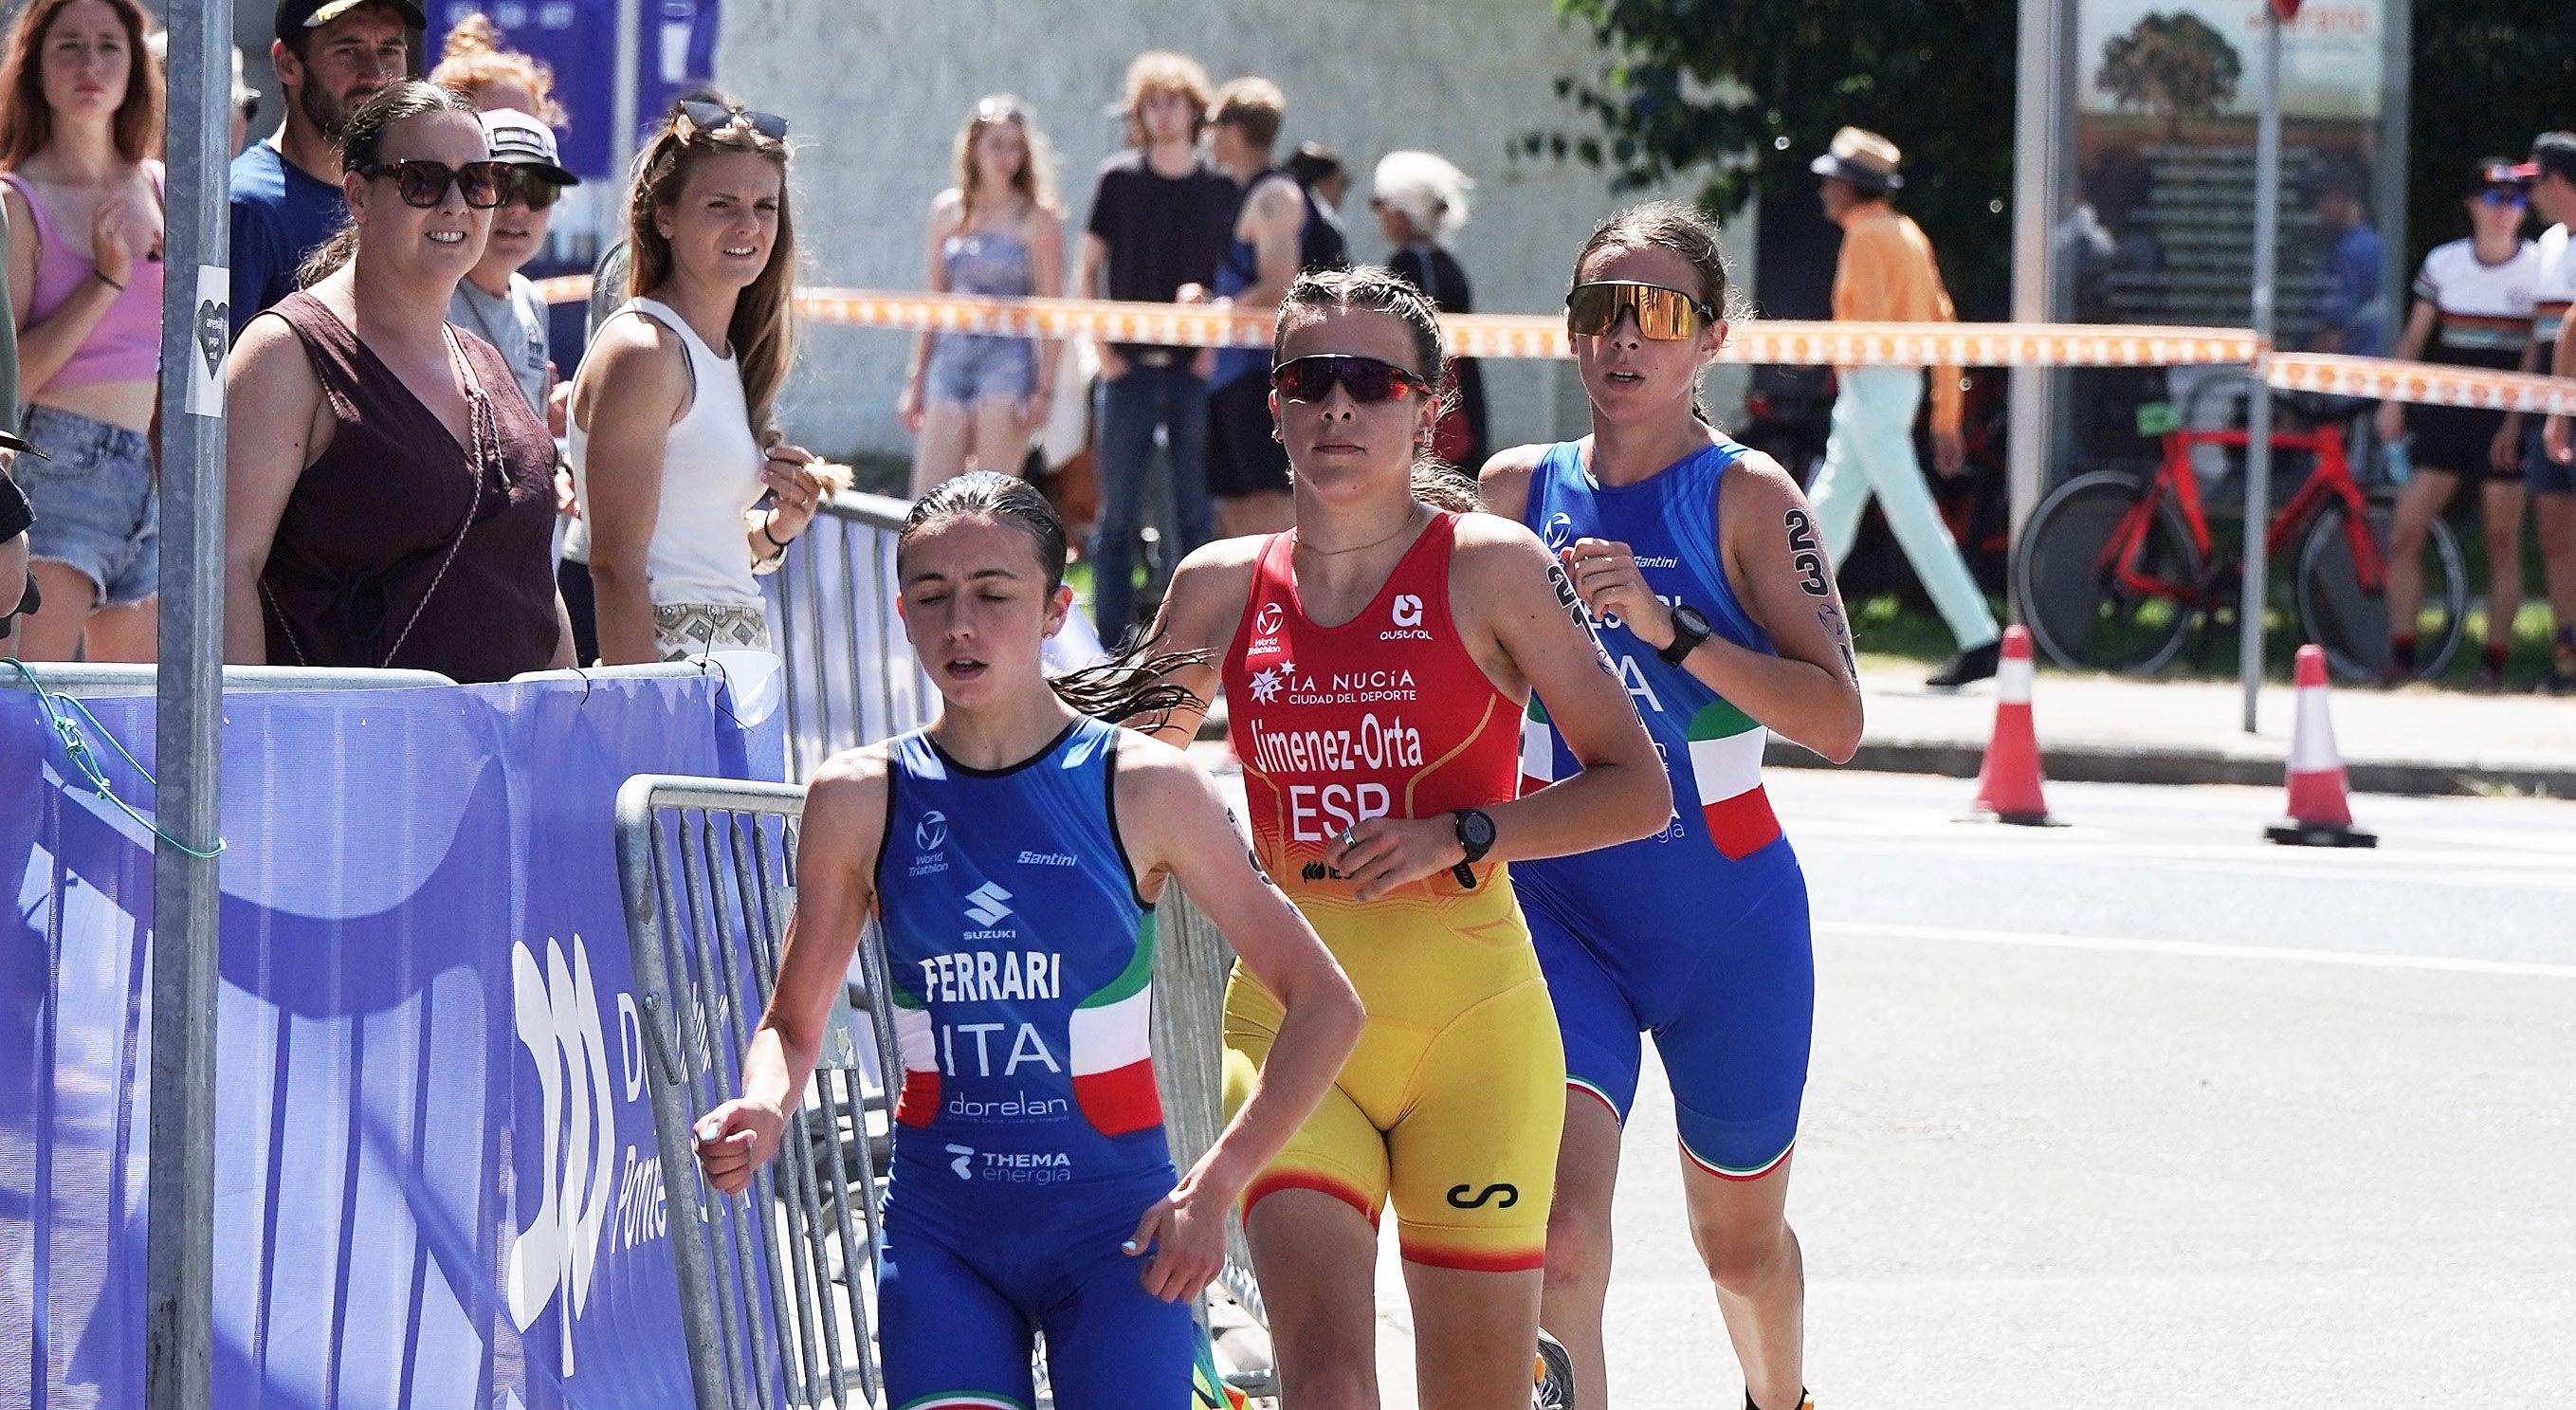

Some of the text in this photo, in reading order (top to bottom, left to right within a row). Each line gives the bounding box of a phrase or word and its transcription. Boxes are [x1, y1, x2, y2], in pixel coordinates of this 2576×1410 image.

[1784, 509, 1829, 597] 23
[1254, 637, 1277, 648] World
[1290, 675, 1316, 691] LA
[1289, 690, 1416, 705] CIUDAD DEL DEPORTE
[1251, 713, 1423, 773] Jimenez-Orta
[1290, 782, 1390, 842] ESP
[915, 851, 944, 865] World
[1017, 851, 1078, 867] Santini
[908, 862, 949, 876] Triathlon
[963, 930, 1015, 940] SUZUKI
[918, 951, 1061, 1002] FERRARI
[942, 1022, 1061, 1076] ITA
[949, 1090, 1068, 1116] dorelan
[982, 1153, 1070, 1167] THEMA
[983, 1167, 1070, 1185] energia
